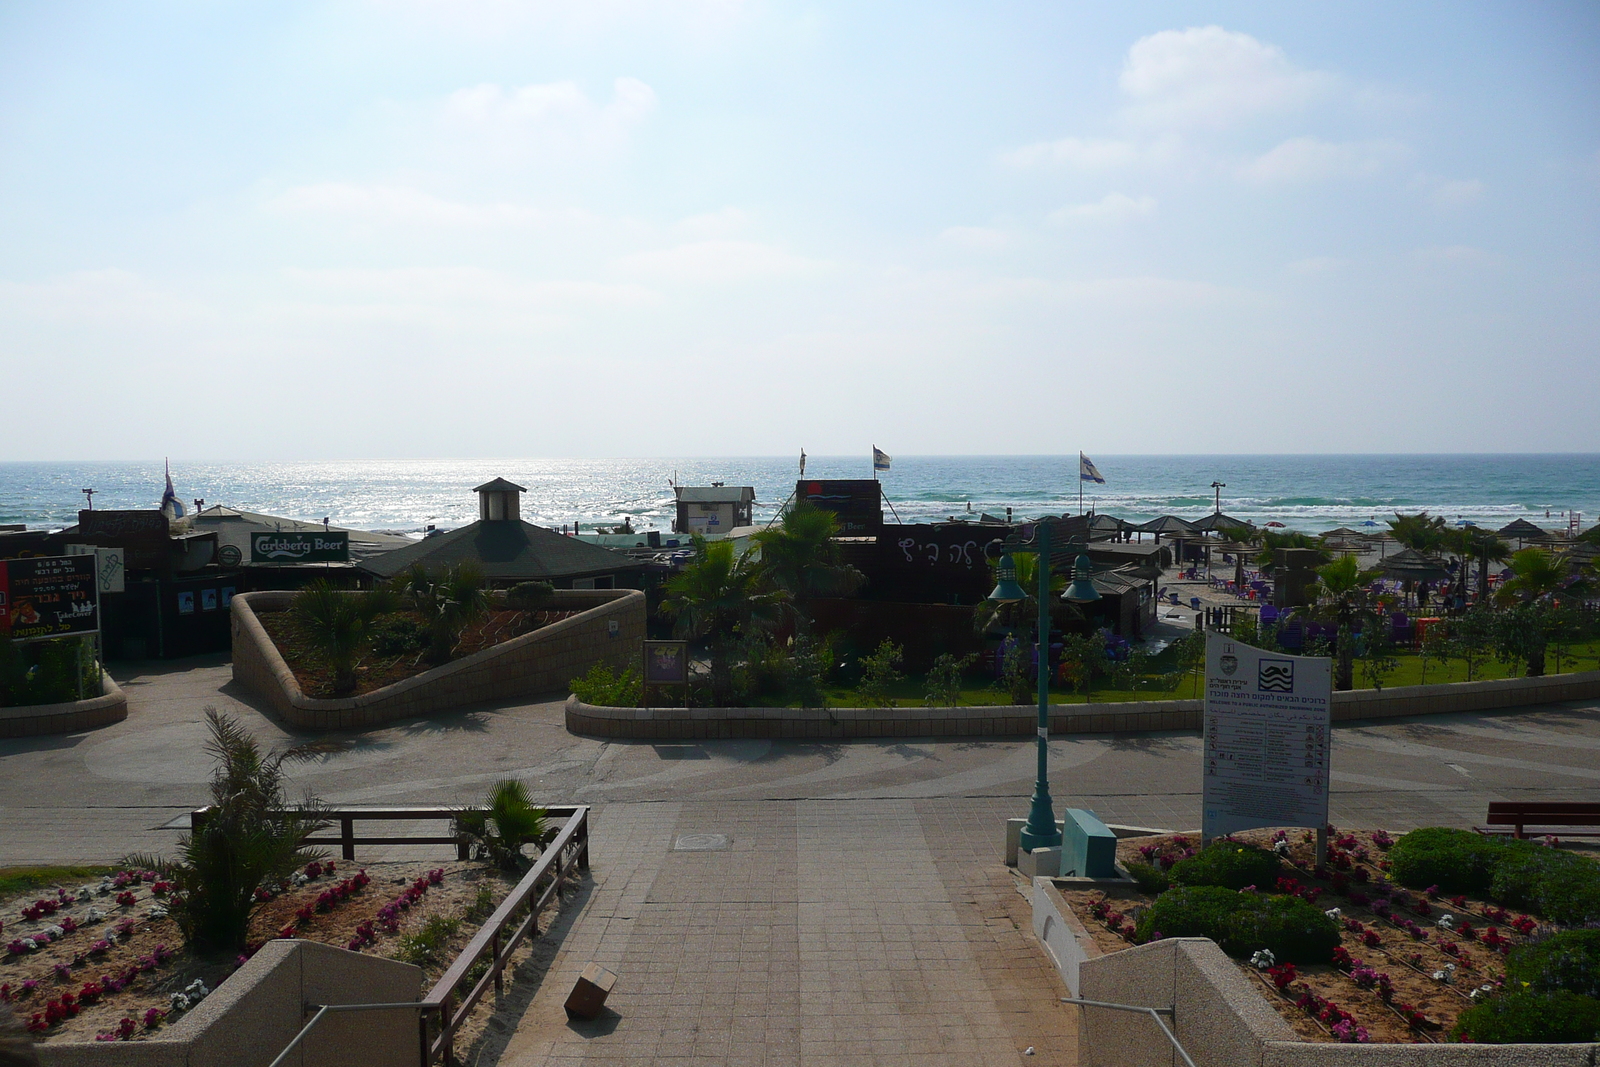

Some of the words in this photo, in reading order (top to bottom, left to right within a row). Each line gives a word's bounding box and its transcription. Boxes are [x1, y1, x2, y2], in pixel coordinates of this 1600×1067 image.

[255, 536, 310, 554] Carlsberg
[314, 538, 343, 550] Beer
[1252, 693, 1274, 701] למקום
